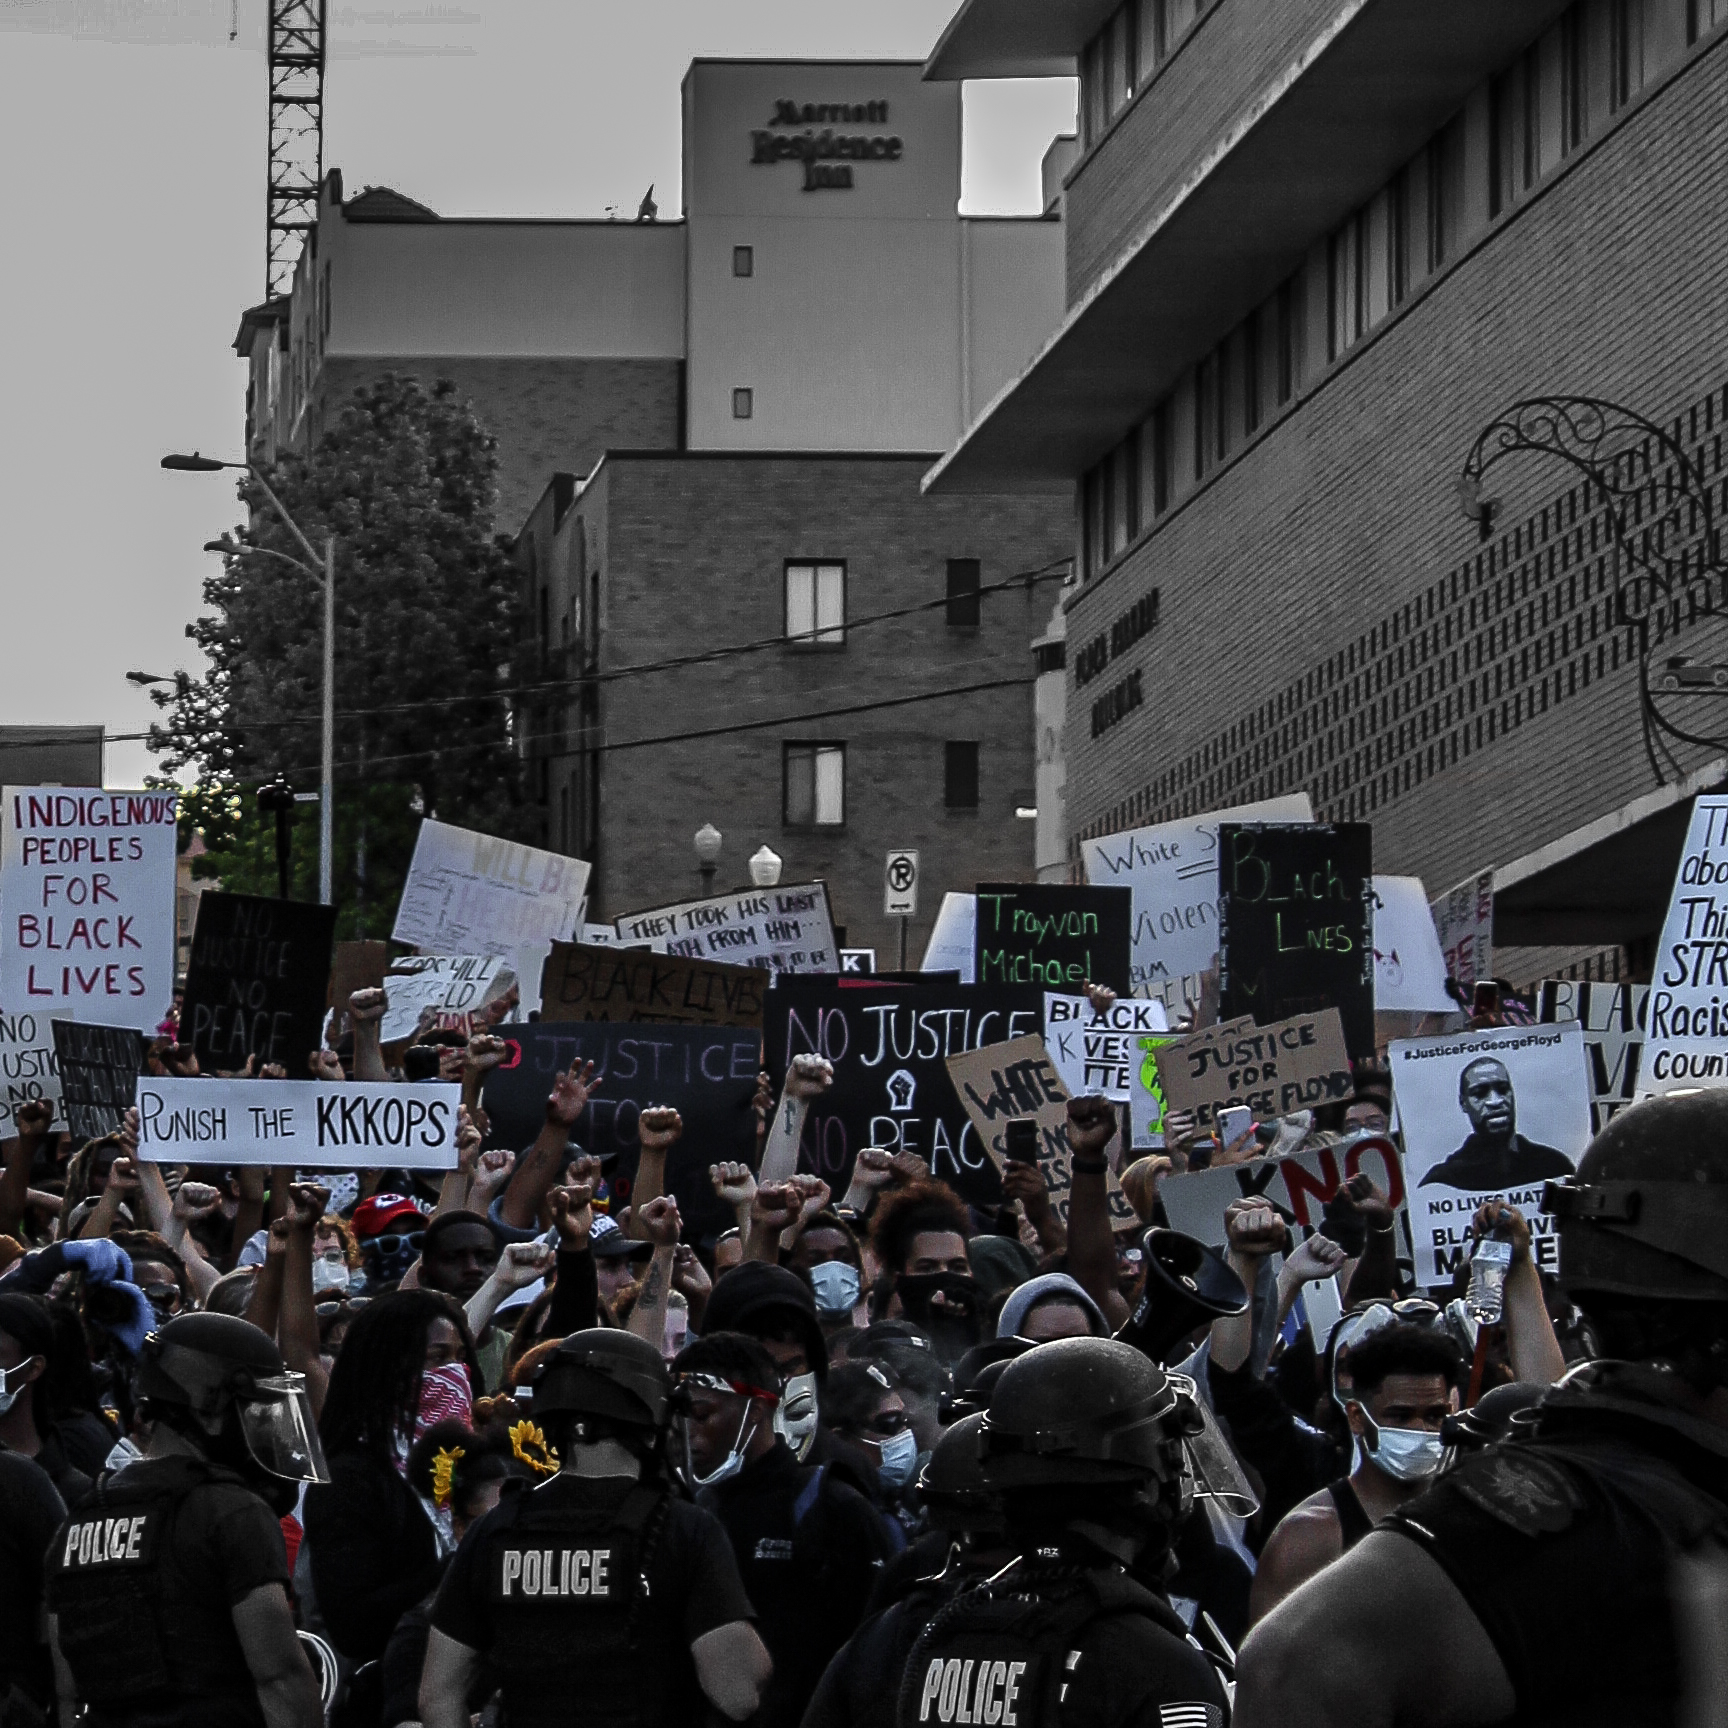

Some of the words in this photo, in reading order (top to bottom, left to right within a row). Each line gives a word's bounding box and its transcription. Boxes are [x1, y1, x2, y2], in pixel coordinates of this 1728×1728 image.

[750, 129, 904, 164] Residence
[14, 795, 176, 828] INDIGENOUS
[23, 837, 143, 865] PEOPLES
[1096, 836, 1181, 874] White
[1681, 850, 1728, 885] abo
[43, 873, 119, 907] FOR
[18, 913, 142, 949] BLACK
[234, 901, 272, 939] NO
[628, 914, 676, 939] THEY
[684, 906, 729, 931] TOOK
[738, 895, 770, 919] HIS
[775, 891, 819, 914] LAST
[978, 893, 1099, 945] Trayvon
[1131, 900, 1219, 946] Violen
[1680, 896, 1728, 939] Thi
[196, 934, 293, 979] JUSTICE
[666, 937, 703, 958] ATH
[708, 924, 758, 953] FROM
[27, 964, 146, 996] LIVES
[560, 946, 677, 1008] BLACK
[682, 966, 763, 1016] LIVES
[983, 948, 1091, 984] Michael
[1663, 941, 1728, 988] STR
[230, 978, 267, 1010] NO
[192, 1002, 293, 1064] PEACE
[785, 1006, 849, 1069] NO
[859, 1004, 1036, 1067] JUSTICE
[1187, 1022, 1317, 1078] JUSTICE
[1404, 1032, 1562, 1060] #JusticeForGeorgeFloyd
[534, 1034, 755, 1084] JUSTICE
[1228, 1062, 1278, 1091] FOR
[8, 1081, 43, 1103] NO
[963, 1058, 1069, 1121] WHITE
[1280, 1069, 1353, 1112] FLOYD
[141, 1091, 227, 1143] PUNISH
[248, 1107, 296, 1139] THE
[316, 1094, 450, 1148] KKKOPS
[868, 1114, 985, 1176] PEAC
[1279, 1138, 1404, 1227] NO
[1428, 1200, 1453, 1215] NO
[1509, 1189, 1543, 1206] MAT
[1432, 1226, 1473, 1247] BLA
[63, 1515, 147, 1568] POLICE
[501, 1548, 611, 1597] POLICE
[919, 1657, 1028, 1727] POLICE
